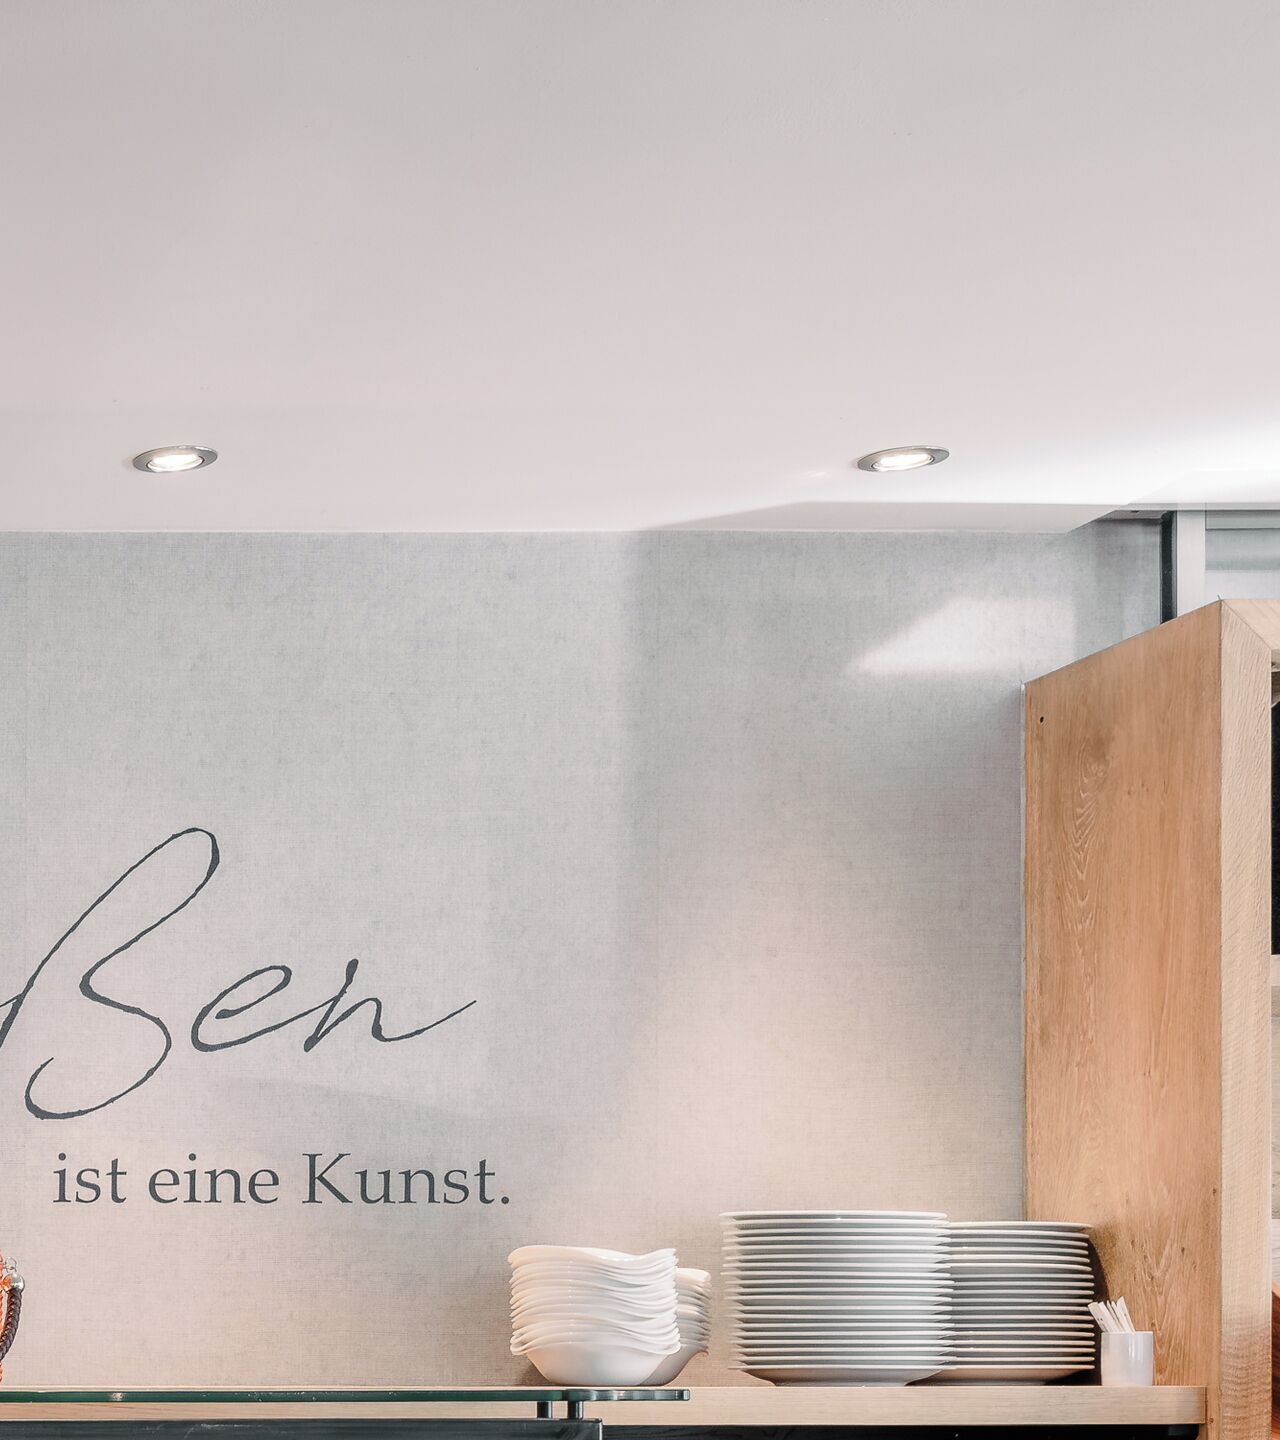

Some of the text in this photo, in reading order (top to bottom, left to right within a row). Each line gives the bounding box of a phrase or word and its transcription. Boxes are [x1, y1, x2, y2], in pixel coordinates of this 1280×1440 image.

[53, 1153, 509, 1204] ist eine Kunst.
